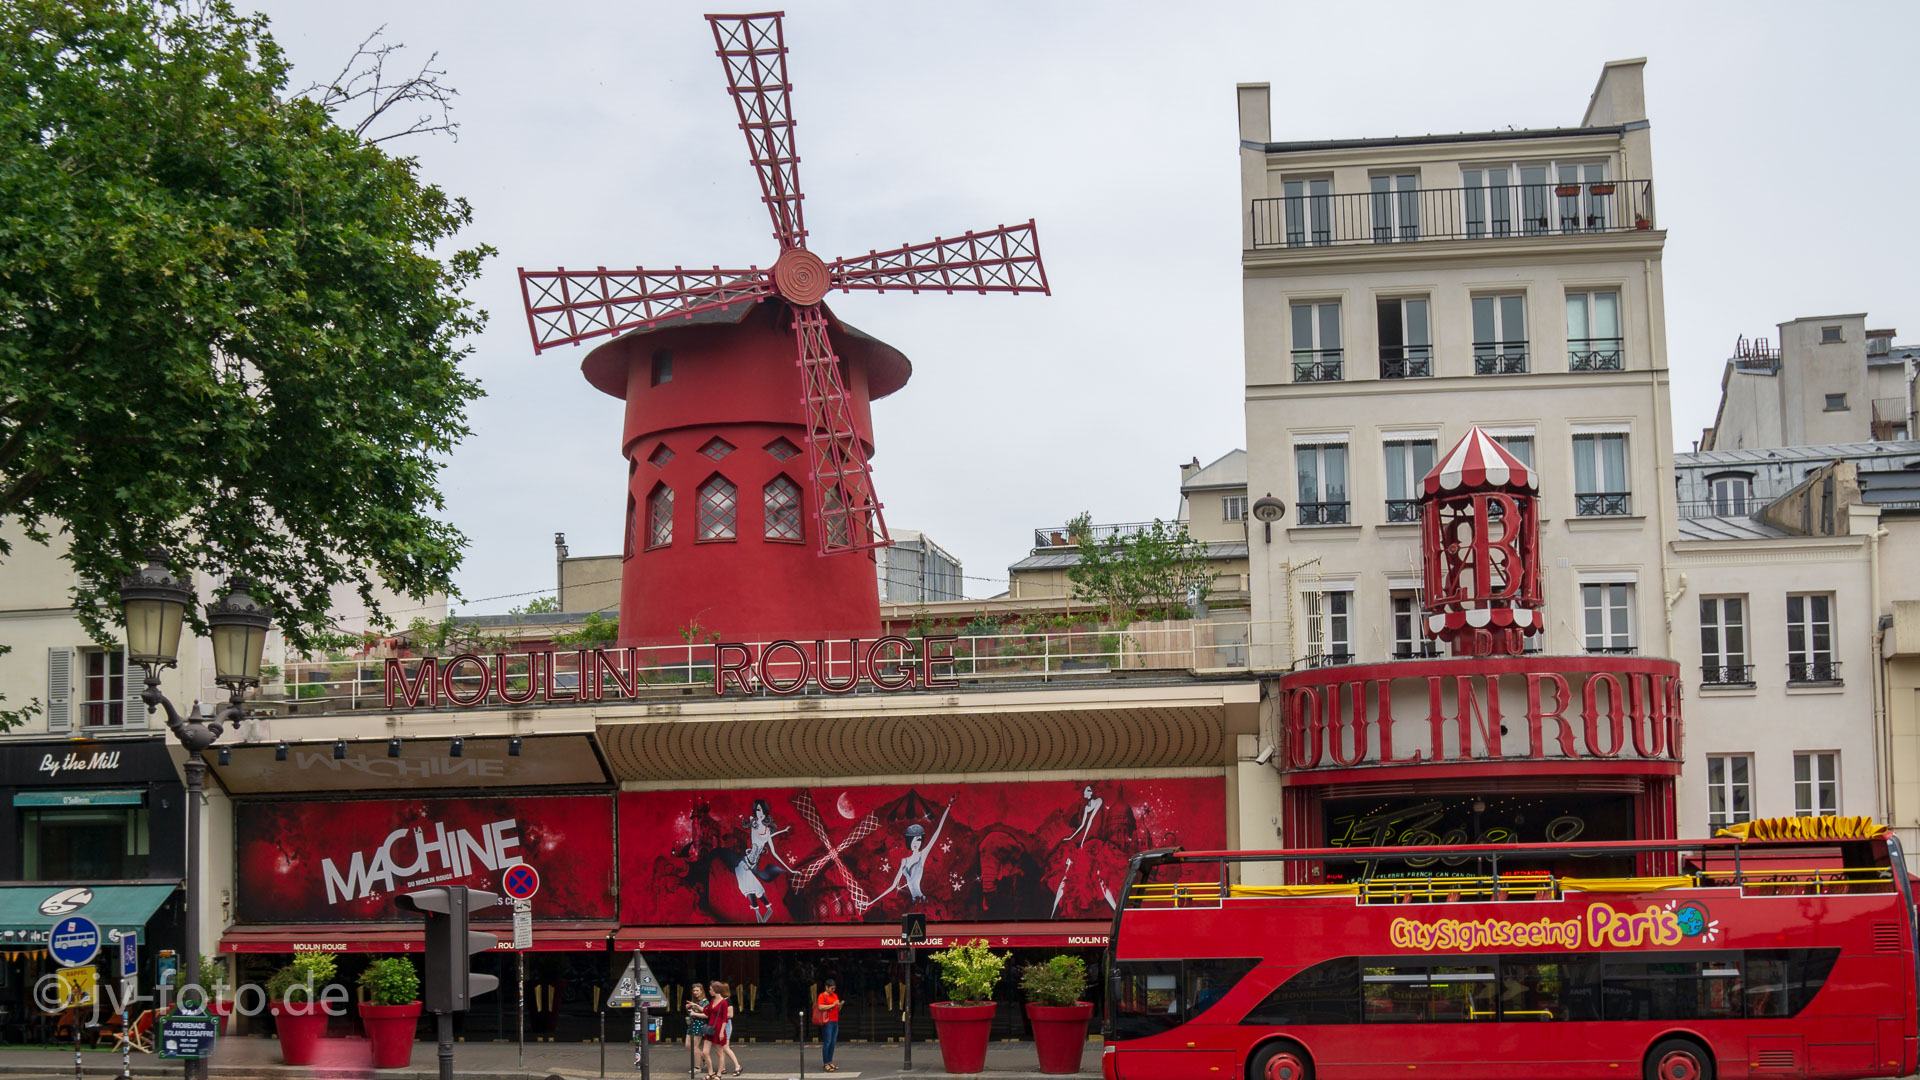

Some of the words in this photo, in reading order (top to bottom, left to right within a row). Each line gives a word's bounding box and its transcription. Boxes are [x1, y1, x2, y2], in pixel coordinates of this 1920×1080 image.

[384, 647, 638, 709] MOULIN
[714, 635, 960, 696] ROUGE
[39, 753, 60, 777] By
[62, 752, 86, 770] the
[87, 750, 120, 770] Mill
[321, 818, 524, 905] MACHINE
[415, 876, 435, 886] MOULIN
[436, 873, 453, 882] ROUGE
[1391, 917, 1581, 950] CitySightseeing
[1587, 902, 1682, 946] Paris
[1068, 936, 1101, 944] MOULIN
[66, 969, 87, 977] RAPPEL
[186, 1030, 214, 1038] LESAFFRE
